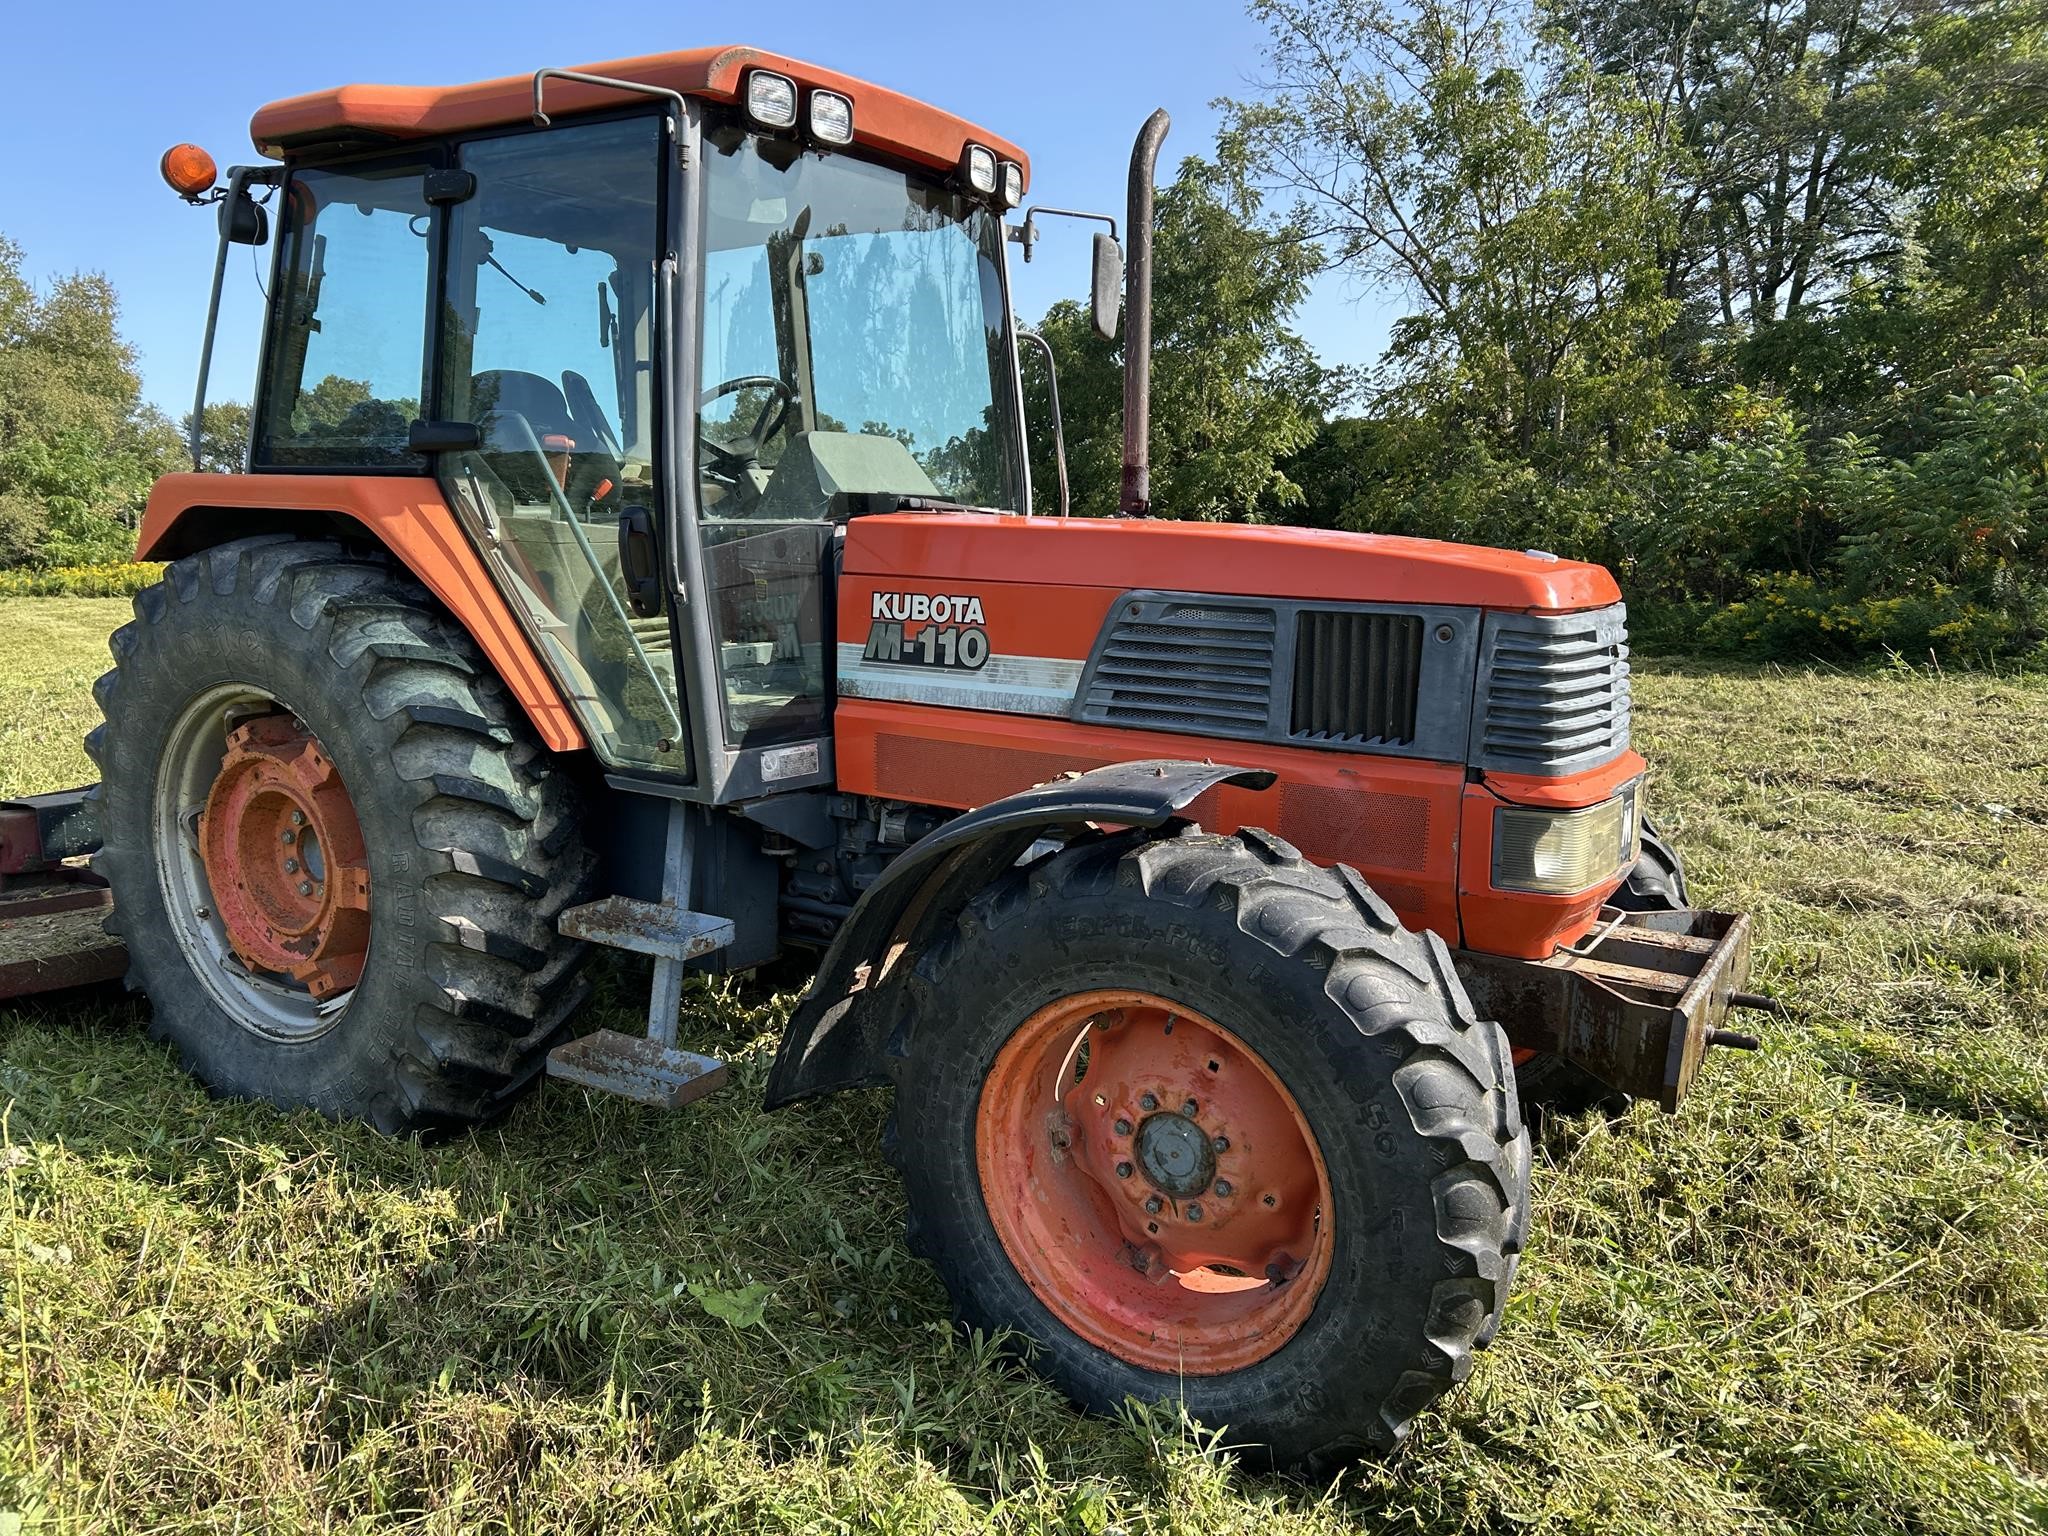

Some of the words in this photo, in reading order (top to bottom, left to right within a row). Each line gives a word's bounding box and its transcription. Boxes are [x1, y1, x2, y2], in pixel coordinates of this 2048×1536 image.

[872, 592, 985, 625] KUBOTA
[863, 622, 989, 669] M-110
[391, 851, 416, 993] RADIAL
[1057, 914, 1229, 966] Earth-Pro
[367, 1008, 401, 1066] ALL
